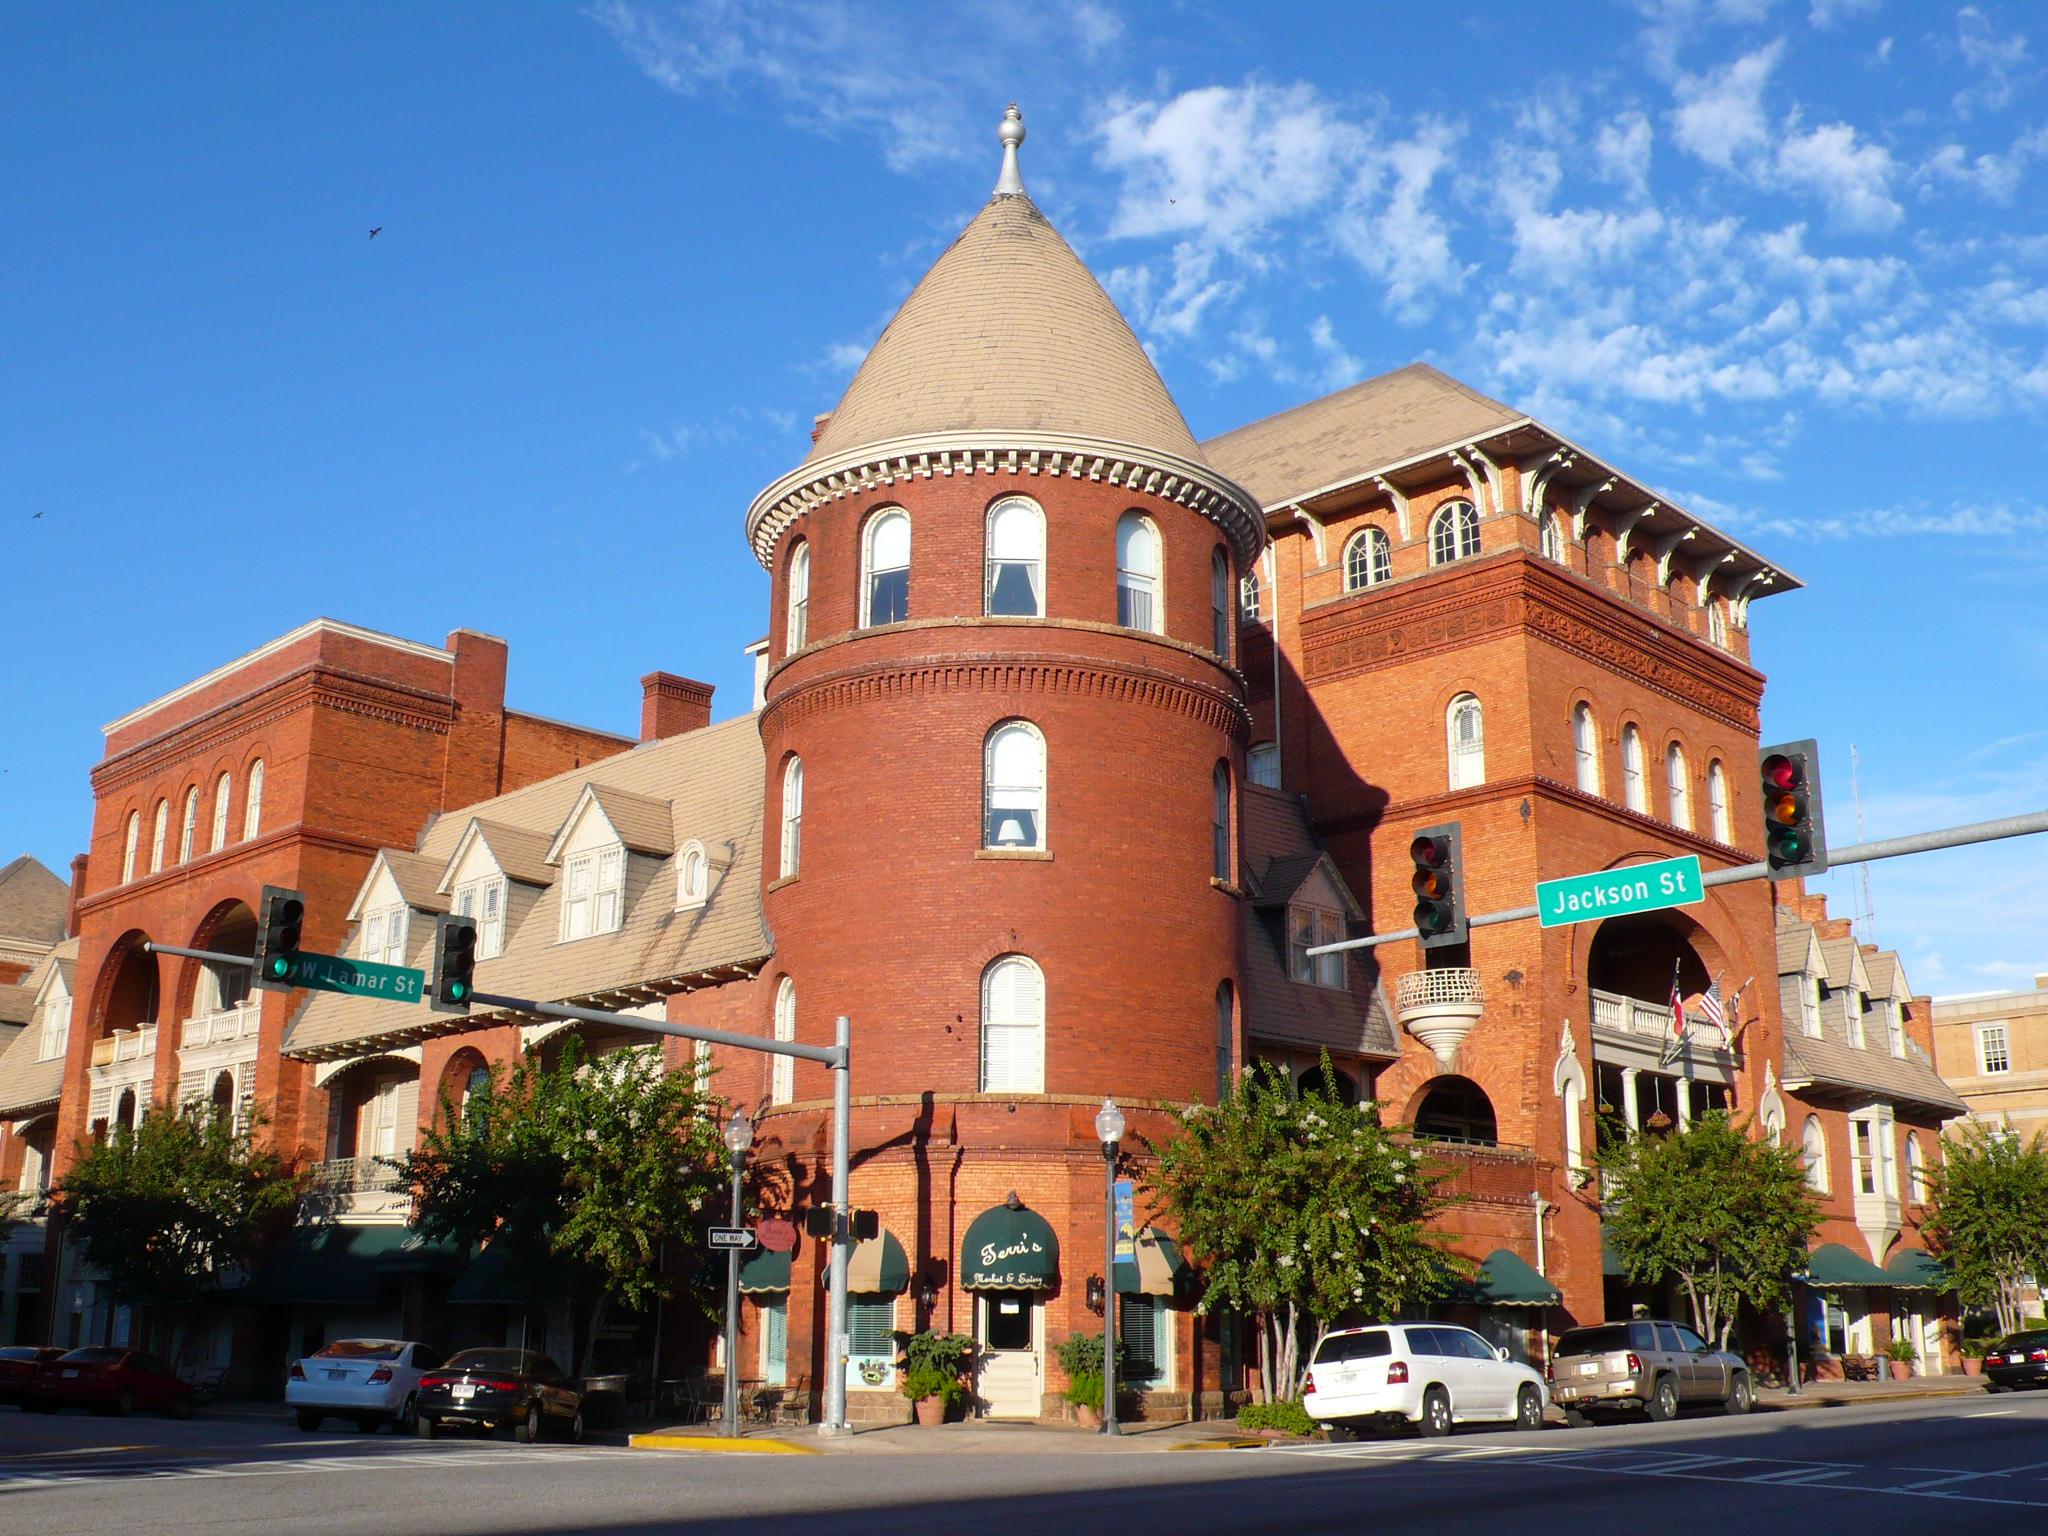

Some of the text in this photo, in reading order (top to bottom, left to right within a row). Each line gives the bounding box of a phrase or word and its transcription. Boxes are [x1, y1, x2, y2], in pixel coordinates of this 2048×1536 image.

[1553, 870, 1687, 914] Jackson St
[303, 962, 415, 994] W Lamar St
[714, 1233, 742, 1242] ONE WAY
[981, 1233, 1043, 1266] Terri's
[974, 1272, 1003, 1284] Market
[1006, 1272, 1015, 1283] &
